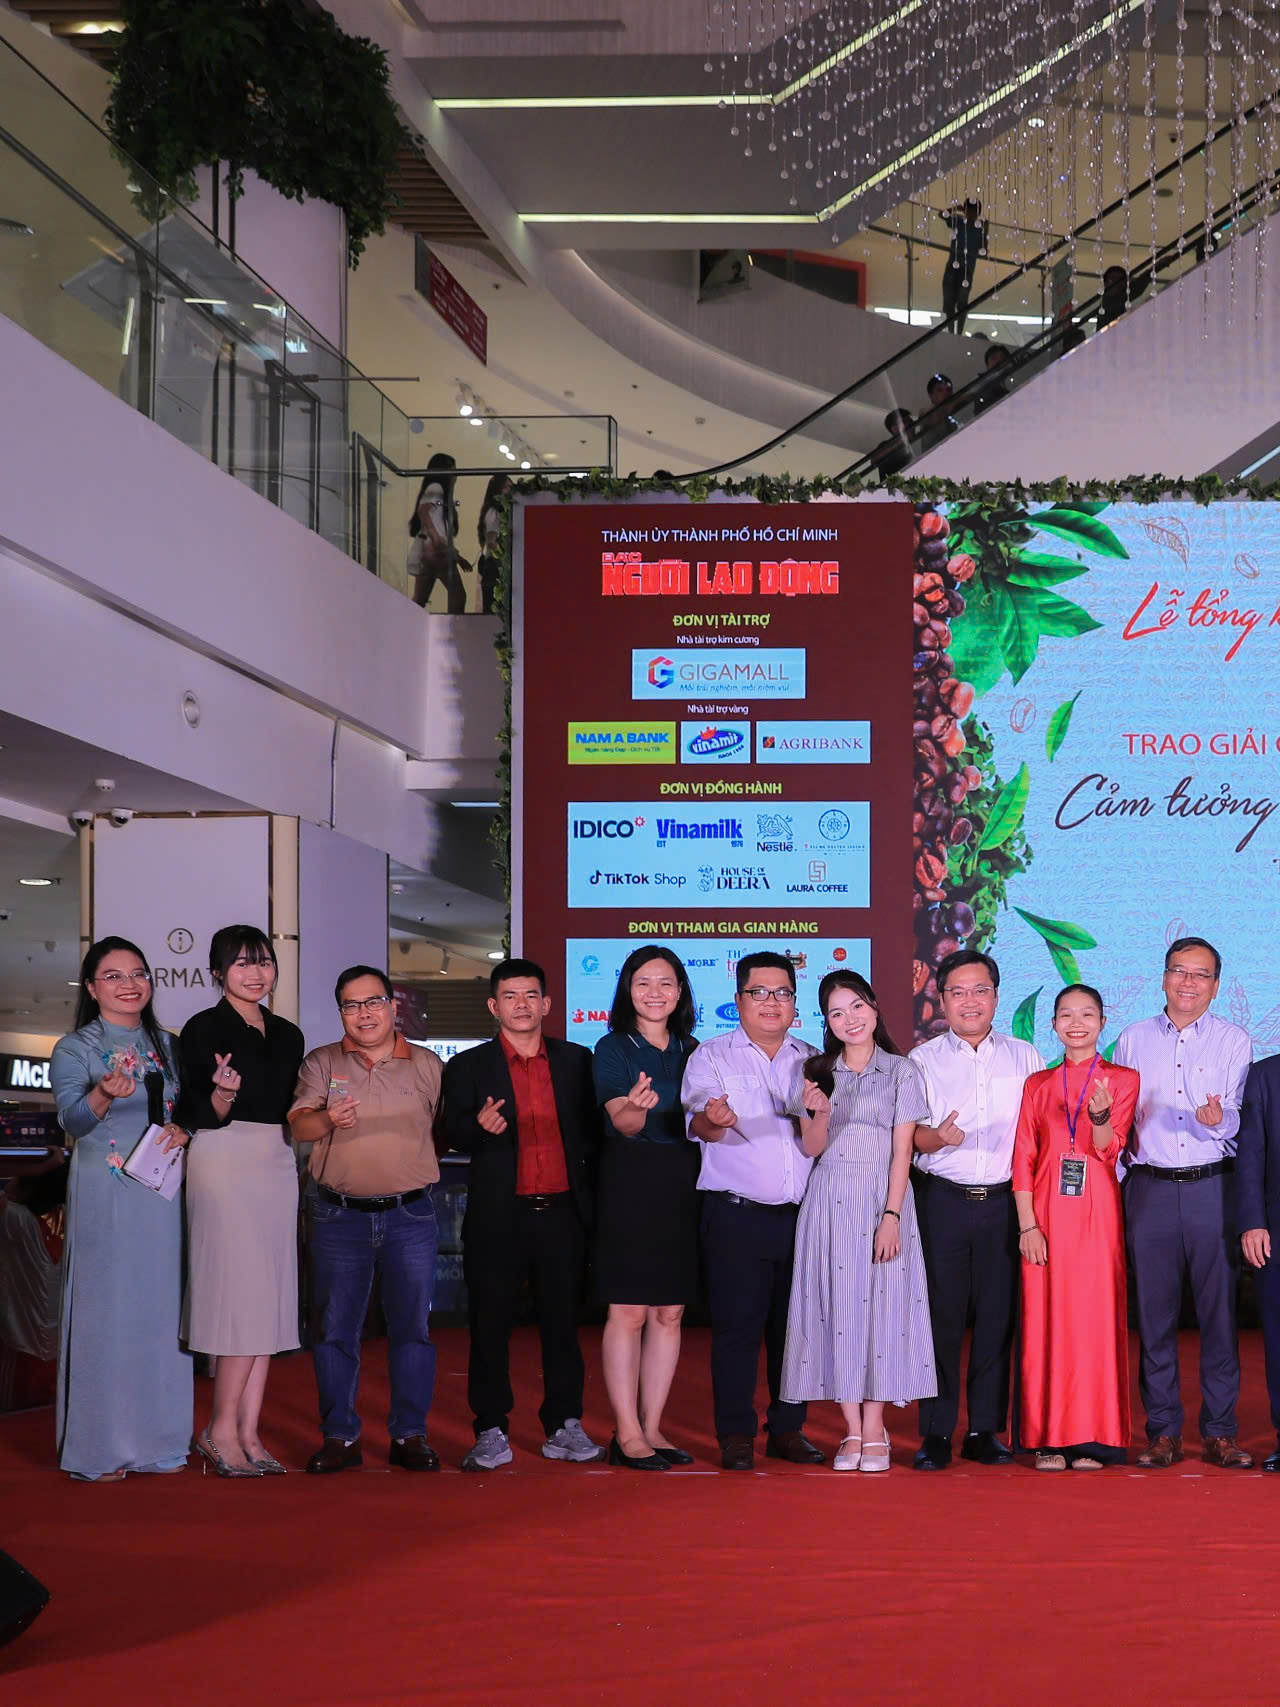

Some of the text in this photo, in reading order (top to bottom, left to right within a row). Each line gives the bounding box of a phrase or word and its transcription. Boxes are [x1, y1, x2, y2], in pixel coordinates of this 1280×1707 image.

[602, 527, 648, 542] THÀNH
[651, 526, 670, 542] ỦY
[672, 527, 718, 542] THÀNH
[721, 525, 750, 541] PHỐ
[776, 526, 800, 541] CHÍ
[802, 528, 838, 541] MINH
[601, 558, 840, 597] NGƯỜI LAO ĐỘNG
[673, 612, 771, 629] ĐƠN VỊ TÀI TRỢ
[1122, 581, 1186, 641] Lễ
[1186, 587, 1264, 662] tổng
[676, 635, 760, 646] Nhà tài trợ kim cương
[679, 663, 790, 681] GIGAMALL
[687, 704, 749, 715] Nhà tài trợ vàng
[575, 732, 669, 744] NAM A BANK
[692, 732, 739, 753] vinamit
[779, 737, 864, 750] AGRIBANK
[1122, 732, 1201, 756] TRAO
[1209, 728, 1266, 756] GIẢI
[659, 779, 782, 797] ĐƠN VỊ ĐỒNG HÀNH
[1054, 772, 1156, 831] Cảm
[1163, 775, 1280, 853] tưởng
[573, 819, 634, 839] IDICO
[656, 818, 743, 839] Vinamilk
[720, 867, 756, 876] HOUSE
[604, 873, 687, 888] TikTok Shop
[717, 876, 771, 890] DEERA
[786, 884, 849, 893] LAURA COFFEE
[628, 919, 819, 936] ĐƠN VỊ THAM GIA GIAN HÀNG
